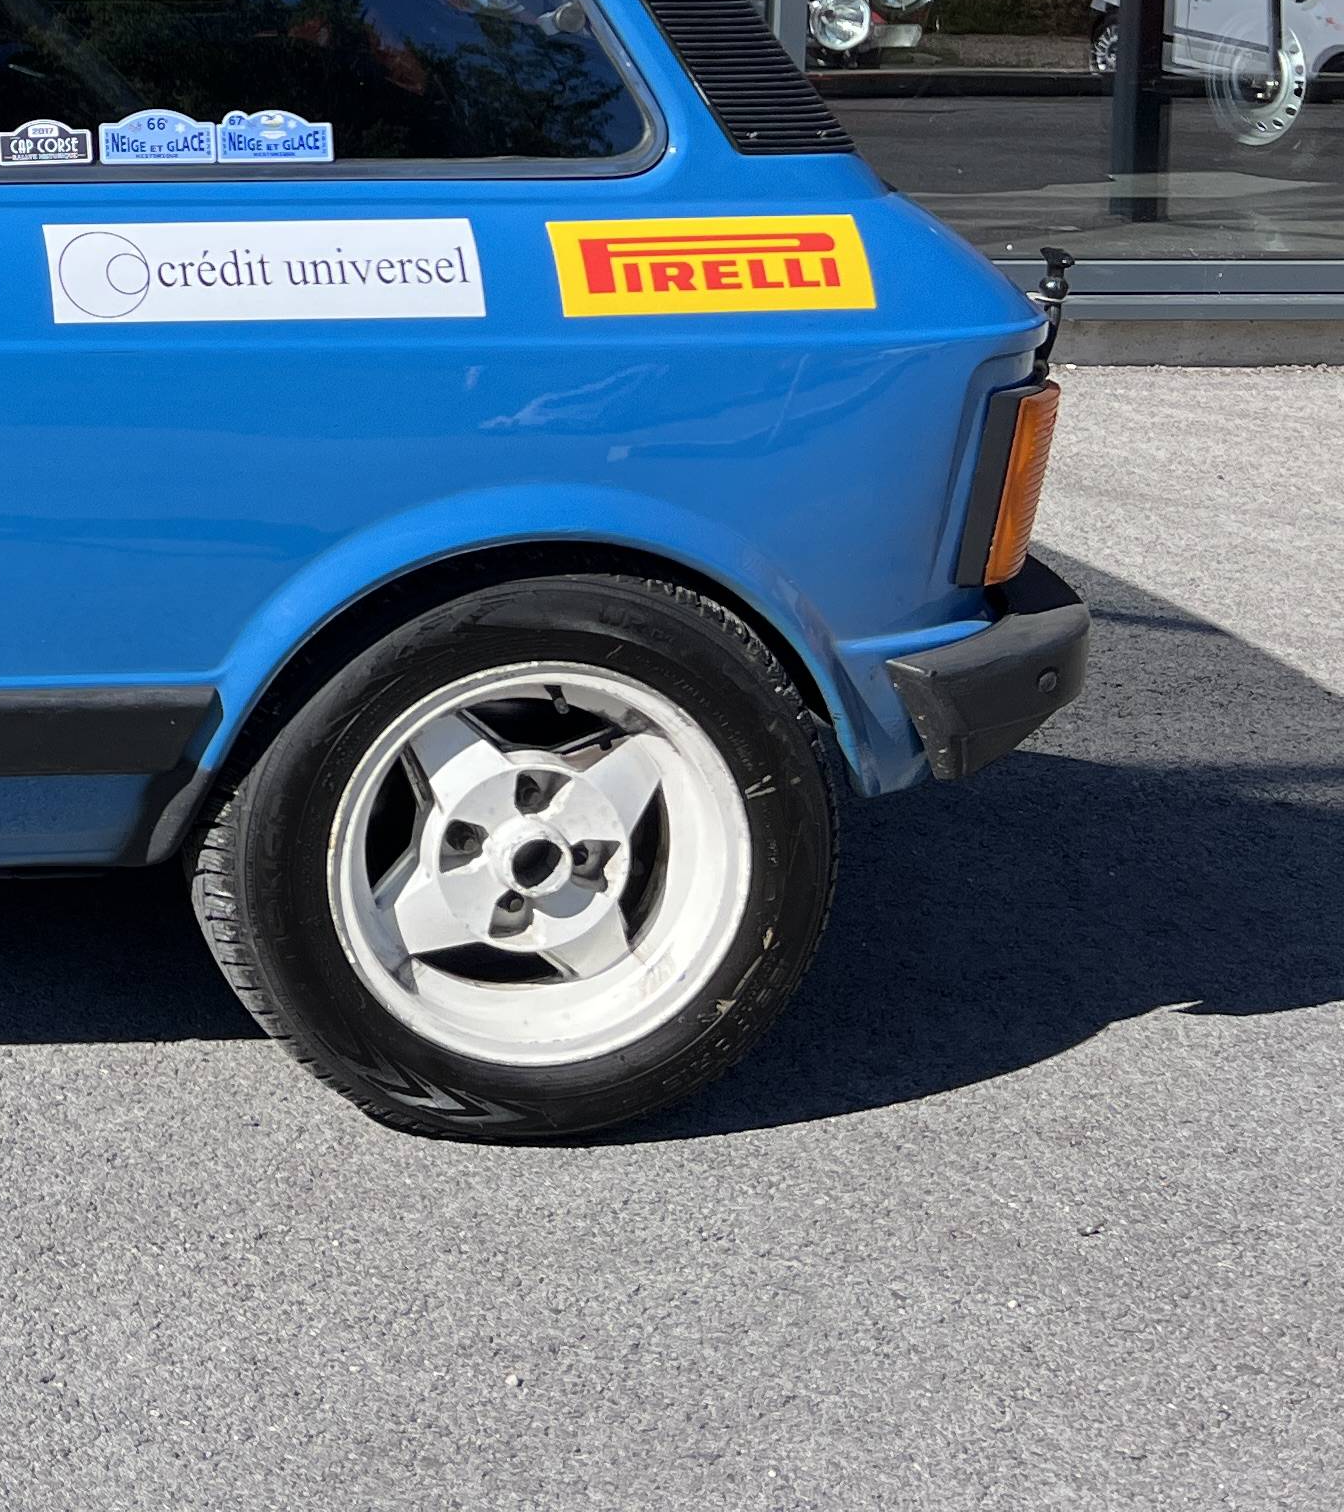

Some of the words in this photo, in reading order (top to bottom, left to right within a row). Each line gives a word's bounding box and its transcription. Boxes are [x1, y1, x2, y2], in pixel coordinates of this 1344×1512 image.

[31, 127, 54, 135] 2017
[111, 132, 147, 153] NEIGE
[150, 144, 164, 153] ET
[167, 131, 205, 152] GLACE
[228, 131, 263, 152] NEIGE
[266, 143, 280, 151] ET
[282, 130, 320, 151] GLACE
[10, 138, 34, 154] CAP
[37, 137, 79, 153] CORSE
[156, 248, 273, 288] crédit
[283, 247, 470, 287] universel
[577, 231, 842, 295] PIRELLI
